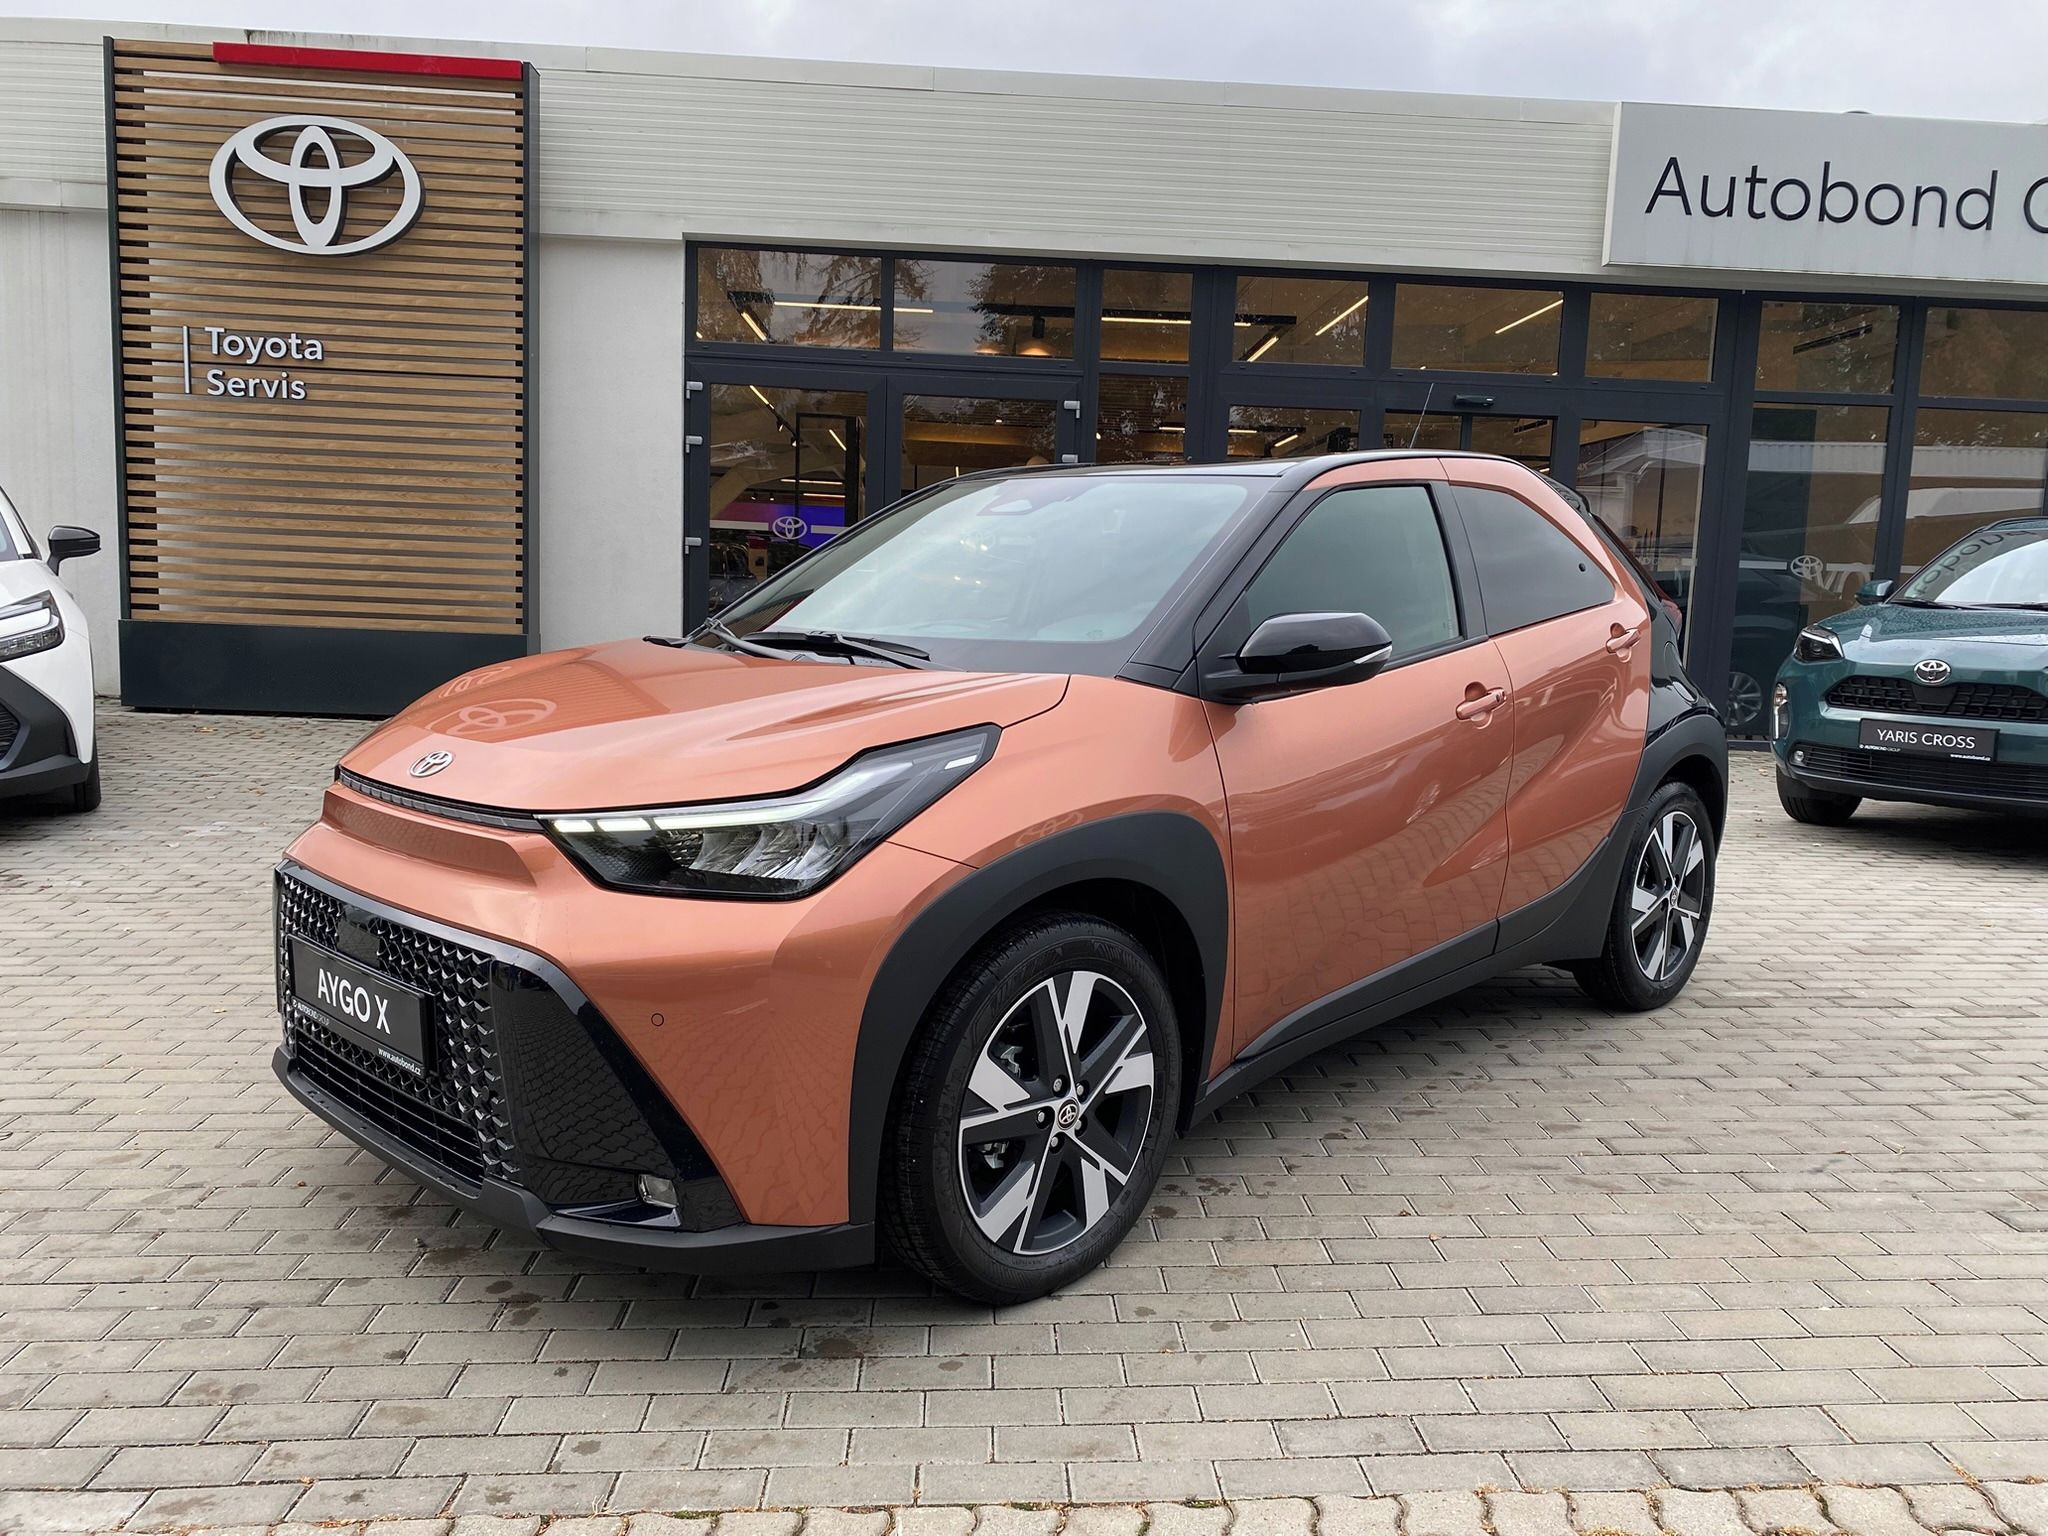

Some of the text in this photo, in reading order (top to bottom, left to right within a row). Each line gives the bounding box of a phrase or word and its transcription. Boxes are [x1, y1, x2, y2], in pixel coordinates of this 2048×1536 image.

[1644, 156, 1999, 231] Autobond
[204, 326, 323, 364] Toyota
[206, 369, 307, 400] Servis
[1876, 728, 1976, 749] YARIS CROSS
[317, 968, 391, 1035] AYGO X
[377, 1048, 422, 1076] www.autobond.cz
